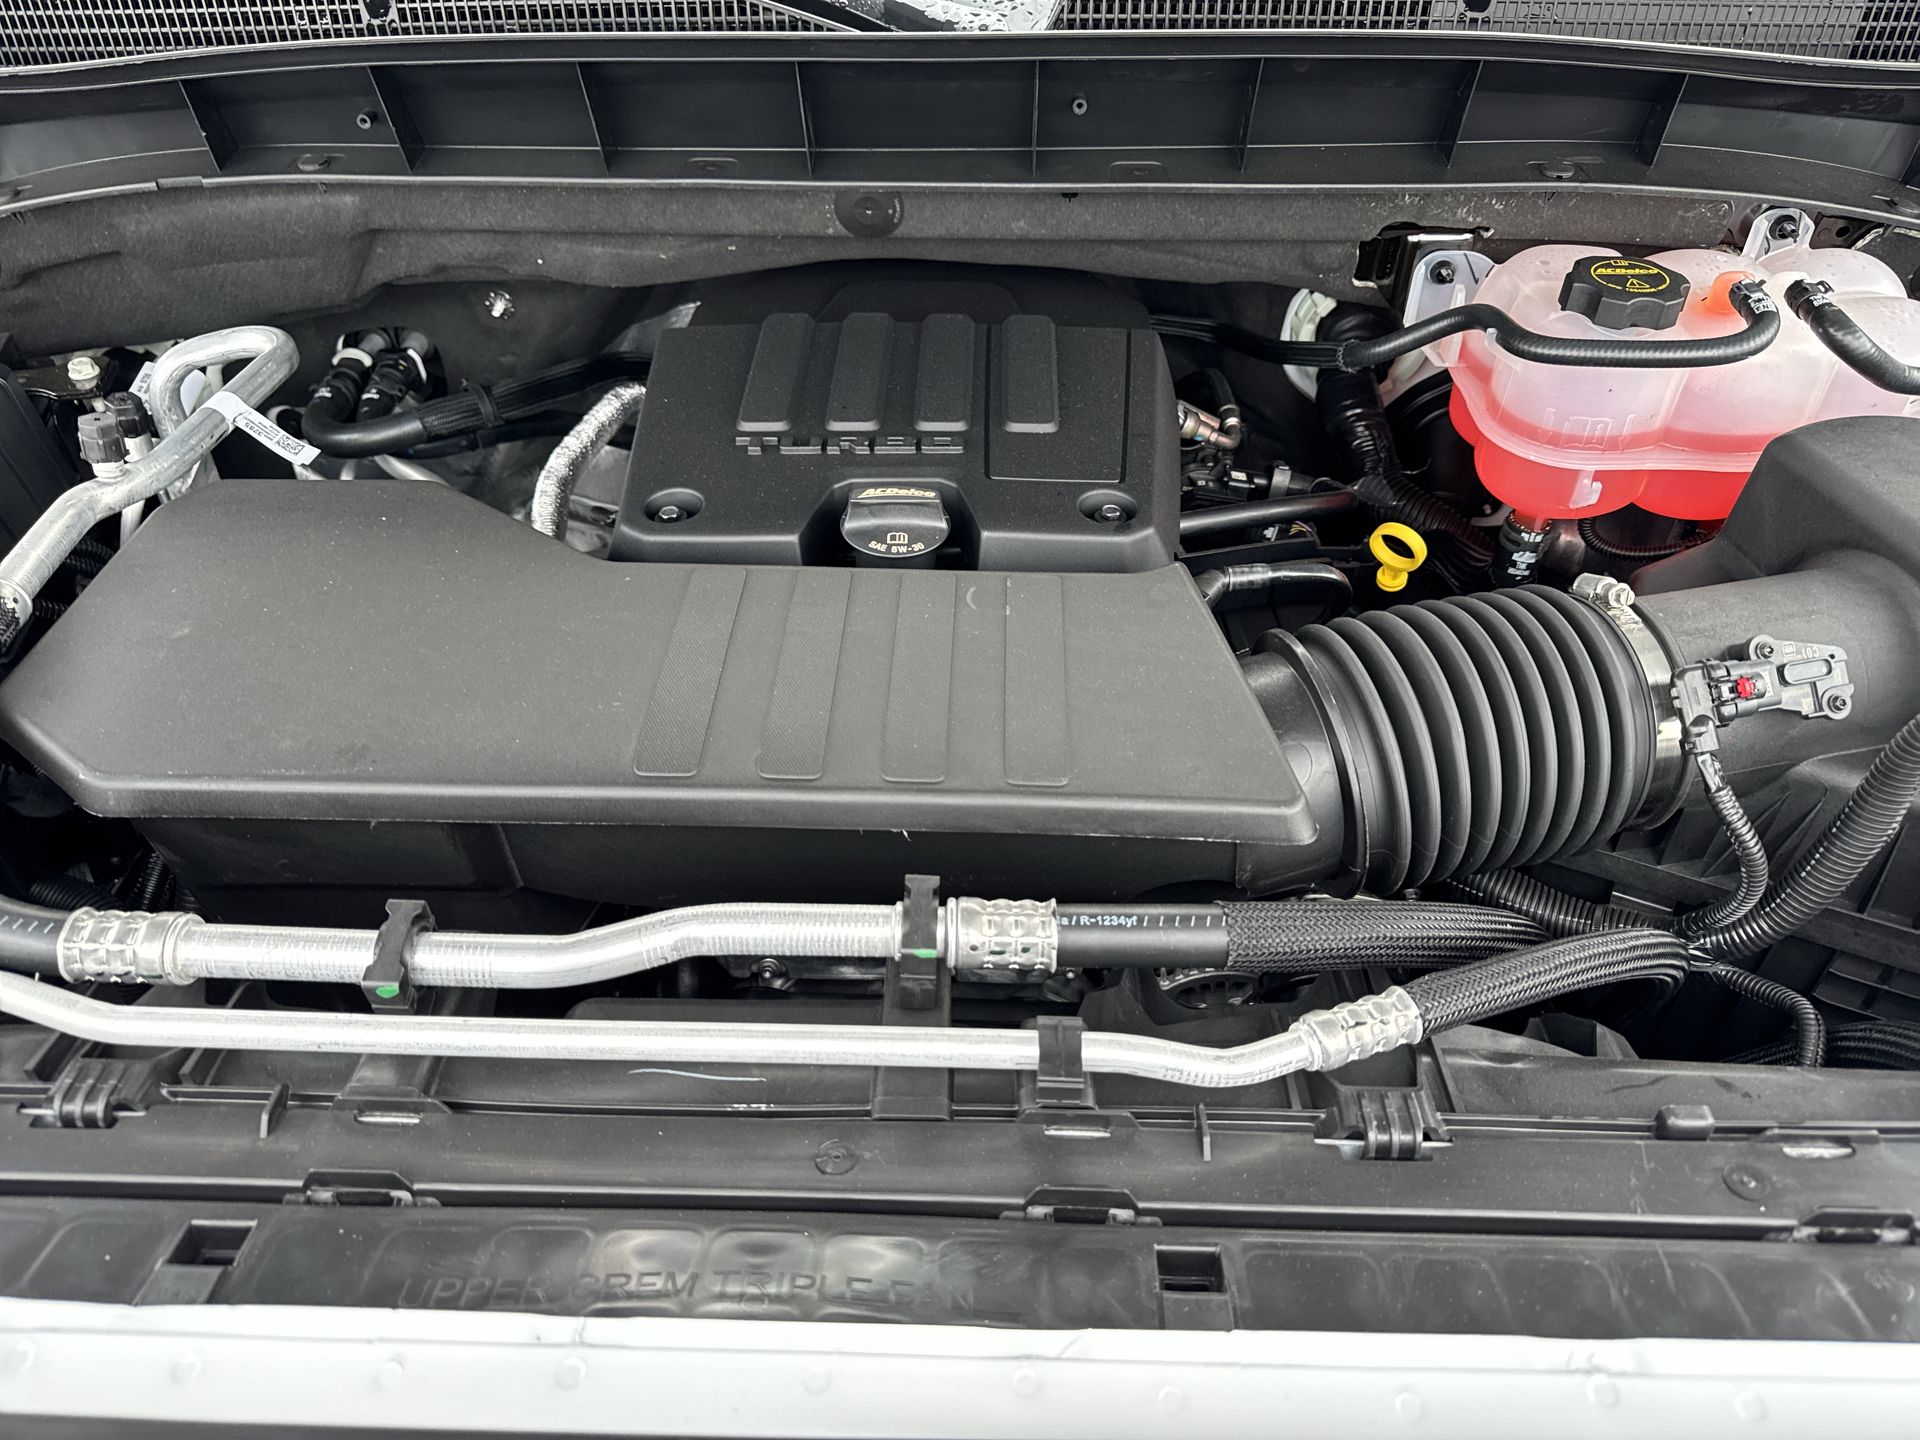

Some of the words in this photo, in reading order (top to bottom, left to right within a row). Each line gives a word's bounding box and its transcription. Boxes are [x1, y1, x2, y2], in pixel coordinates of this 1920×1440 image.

[1594, 267, 1659, 275] ACDelco
[857, 488, 936, 498] ACDelco
[868, 540, 888, 552] SAE
[890, 542, 925, 553] 5W-30
[1080, 915, 1138, 928] R-1234yf
[398, 1276, 552, 1307] UPPER
[713, 1269, 876, 1302] TRIPLE
